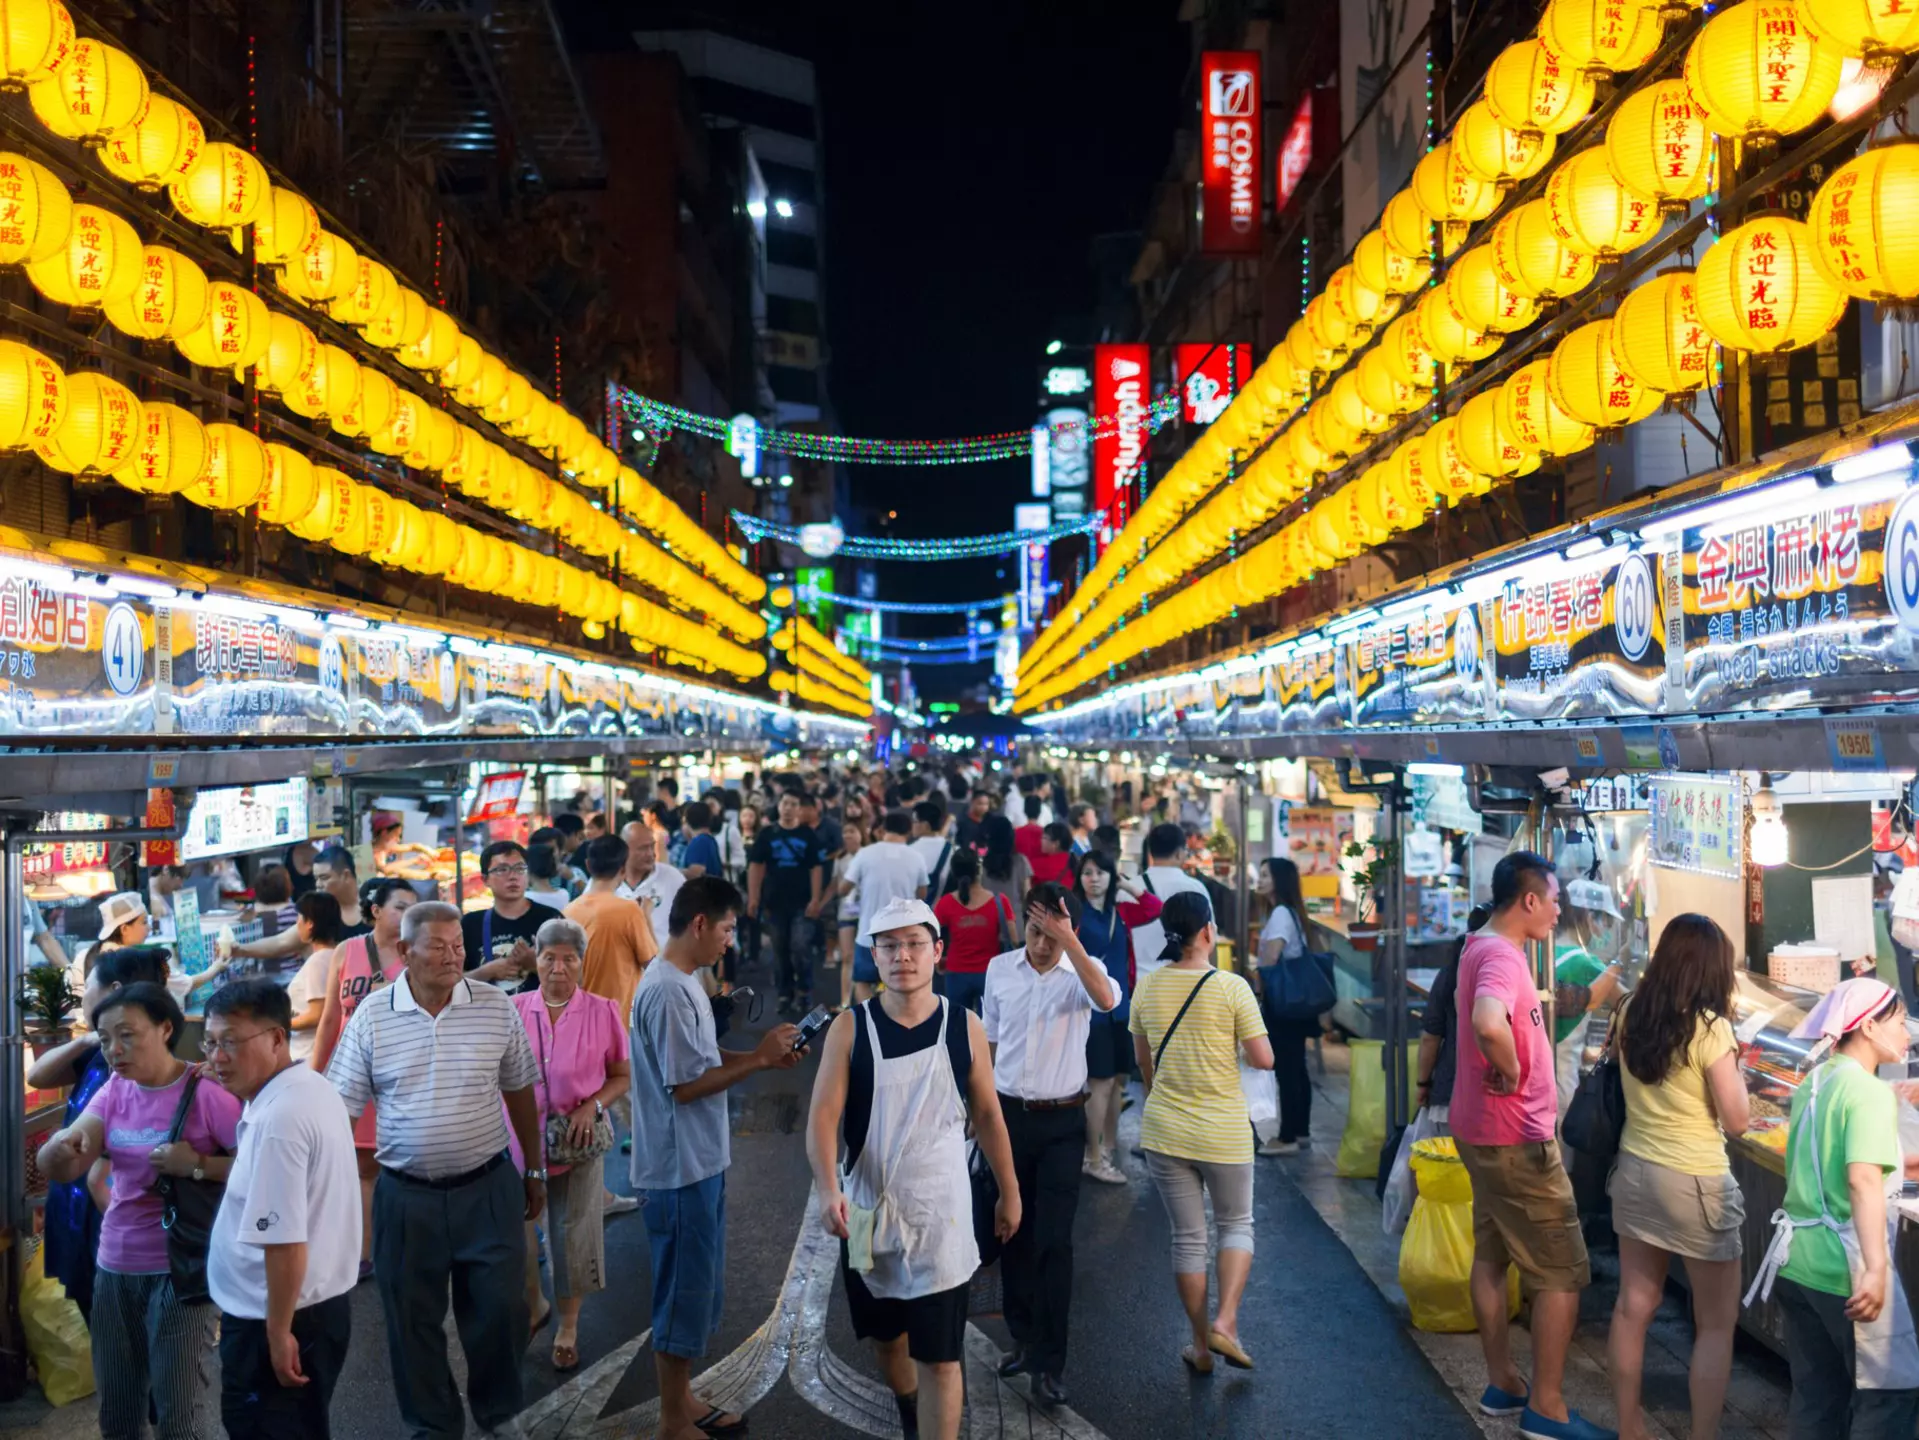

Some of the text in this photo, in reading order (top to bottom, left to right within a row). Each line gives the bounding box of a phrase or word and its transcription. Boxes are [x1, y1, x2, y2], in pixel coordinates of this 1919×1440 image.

[1765, 19, 1796, 102] 開漳聖王
[1663, 105, 1691, 178] 開漳聖王
[0, 163, 25, 245] 歡迎光臨
[1230, 121, 1253, 233] COSMED
[1621, 201, 1648, 233] 聖王
[1828, 172, 1872, 282] 廟口攤販小組
[79, 216, 102, 289] 歡迎光臨
[1748, 232, 1778, 329] 歡迎光臨
[144, 256, 164, 323] 歡迎光臨
[219, 291, 239, 353] 歡迎光臨
[34, 358, 58, 437] 廟口攤販小組
[1609, 370, 1633, 408] 光臨
[104, 400, 129, 459] 開漳聖王
[1624, 573, 1645, 639] 60
[112, 623, 134, 679] 41
[324, 648, 338, 688] 39
[1768, 644, 1840, 679] snacks
[1839, 733, 1873, 756] 1950
